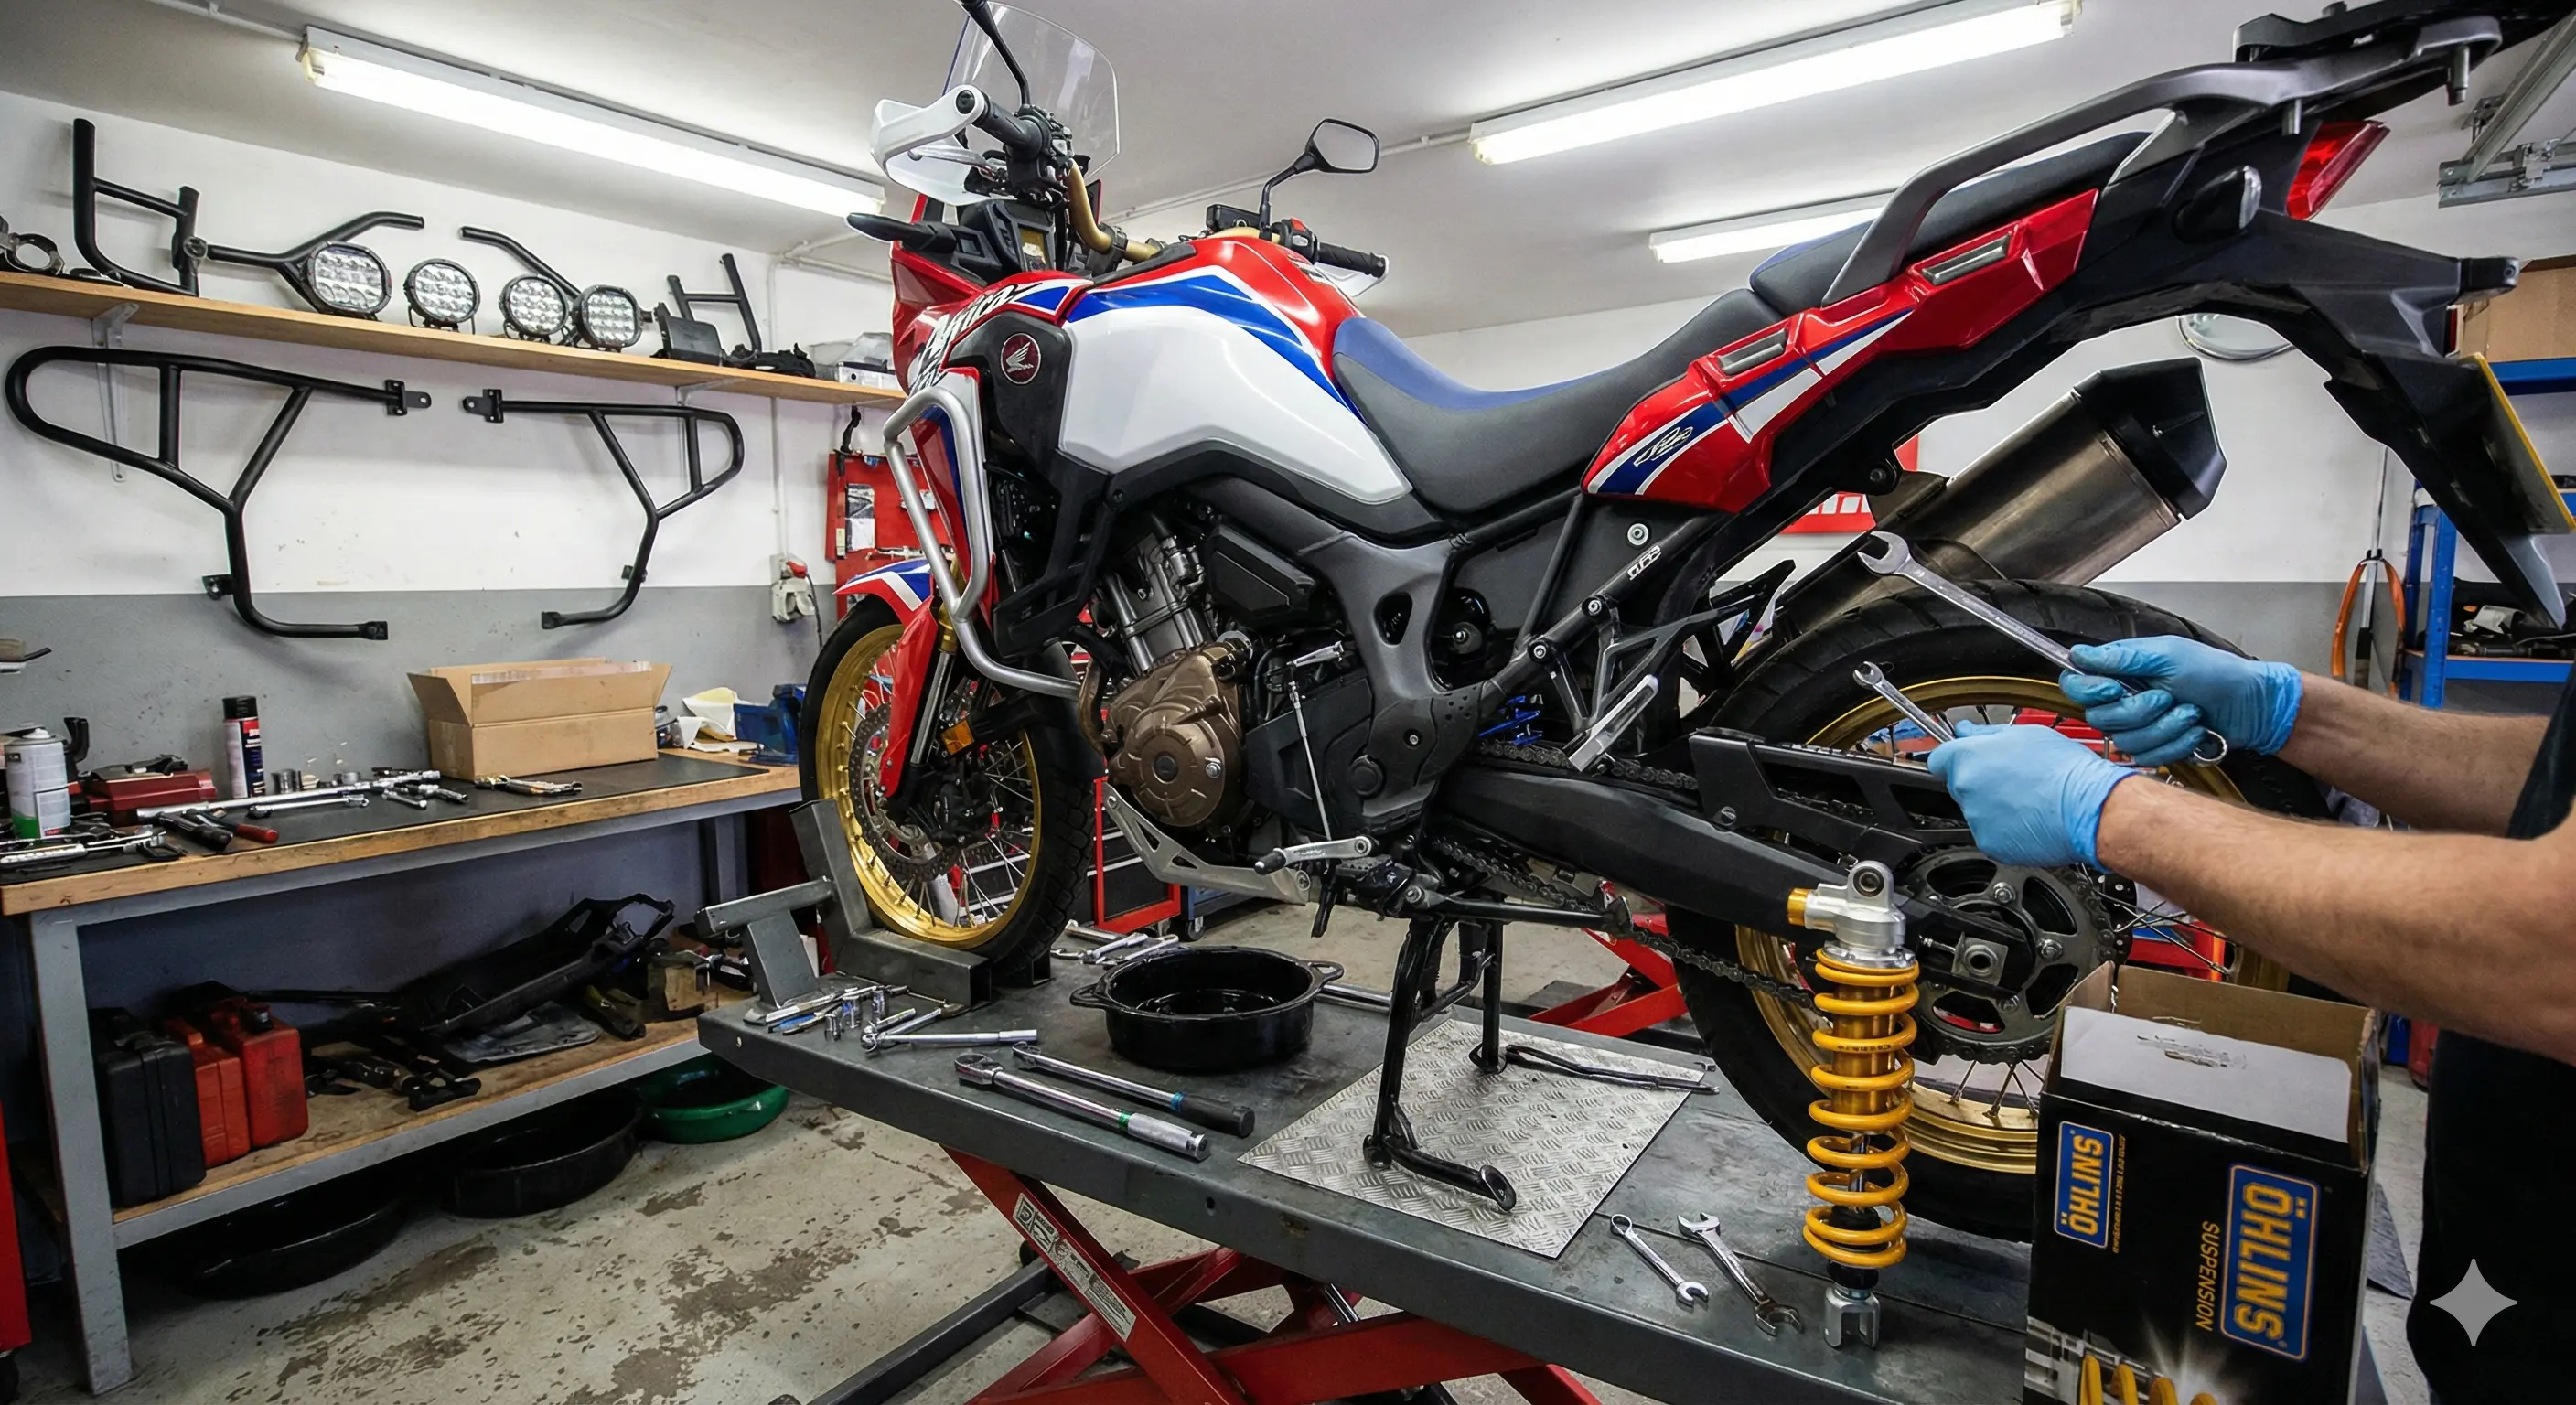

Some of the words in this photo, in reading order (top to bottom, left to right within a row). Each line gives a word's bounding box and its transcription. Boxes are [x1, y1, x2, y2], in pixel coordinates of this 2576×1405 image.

[2061, 1134, 2103, 1236] ÖHLINS
[2195, 1220, 2221, 1331] SUSPENSION
[2234, 1182, 2307, 1340] ÖHLINS
